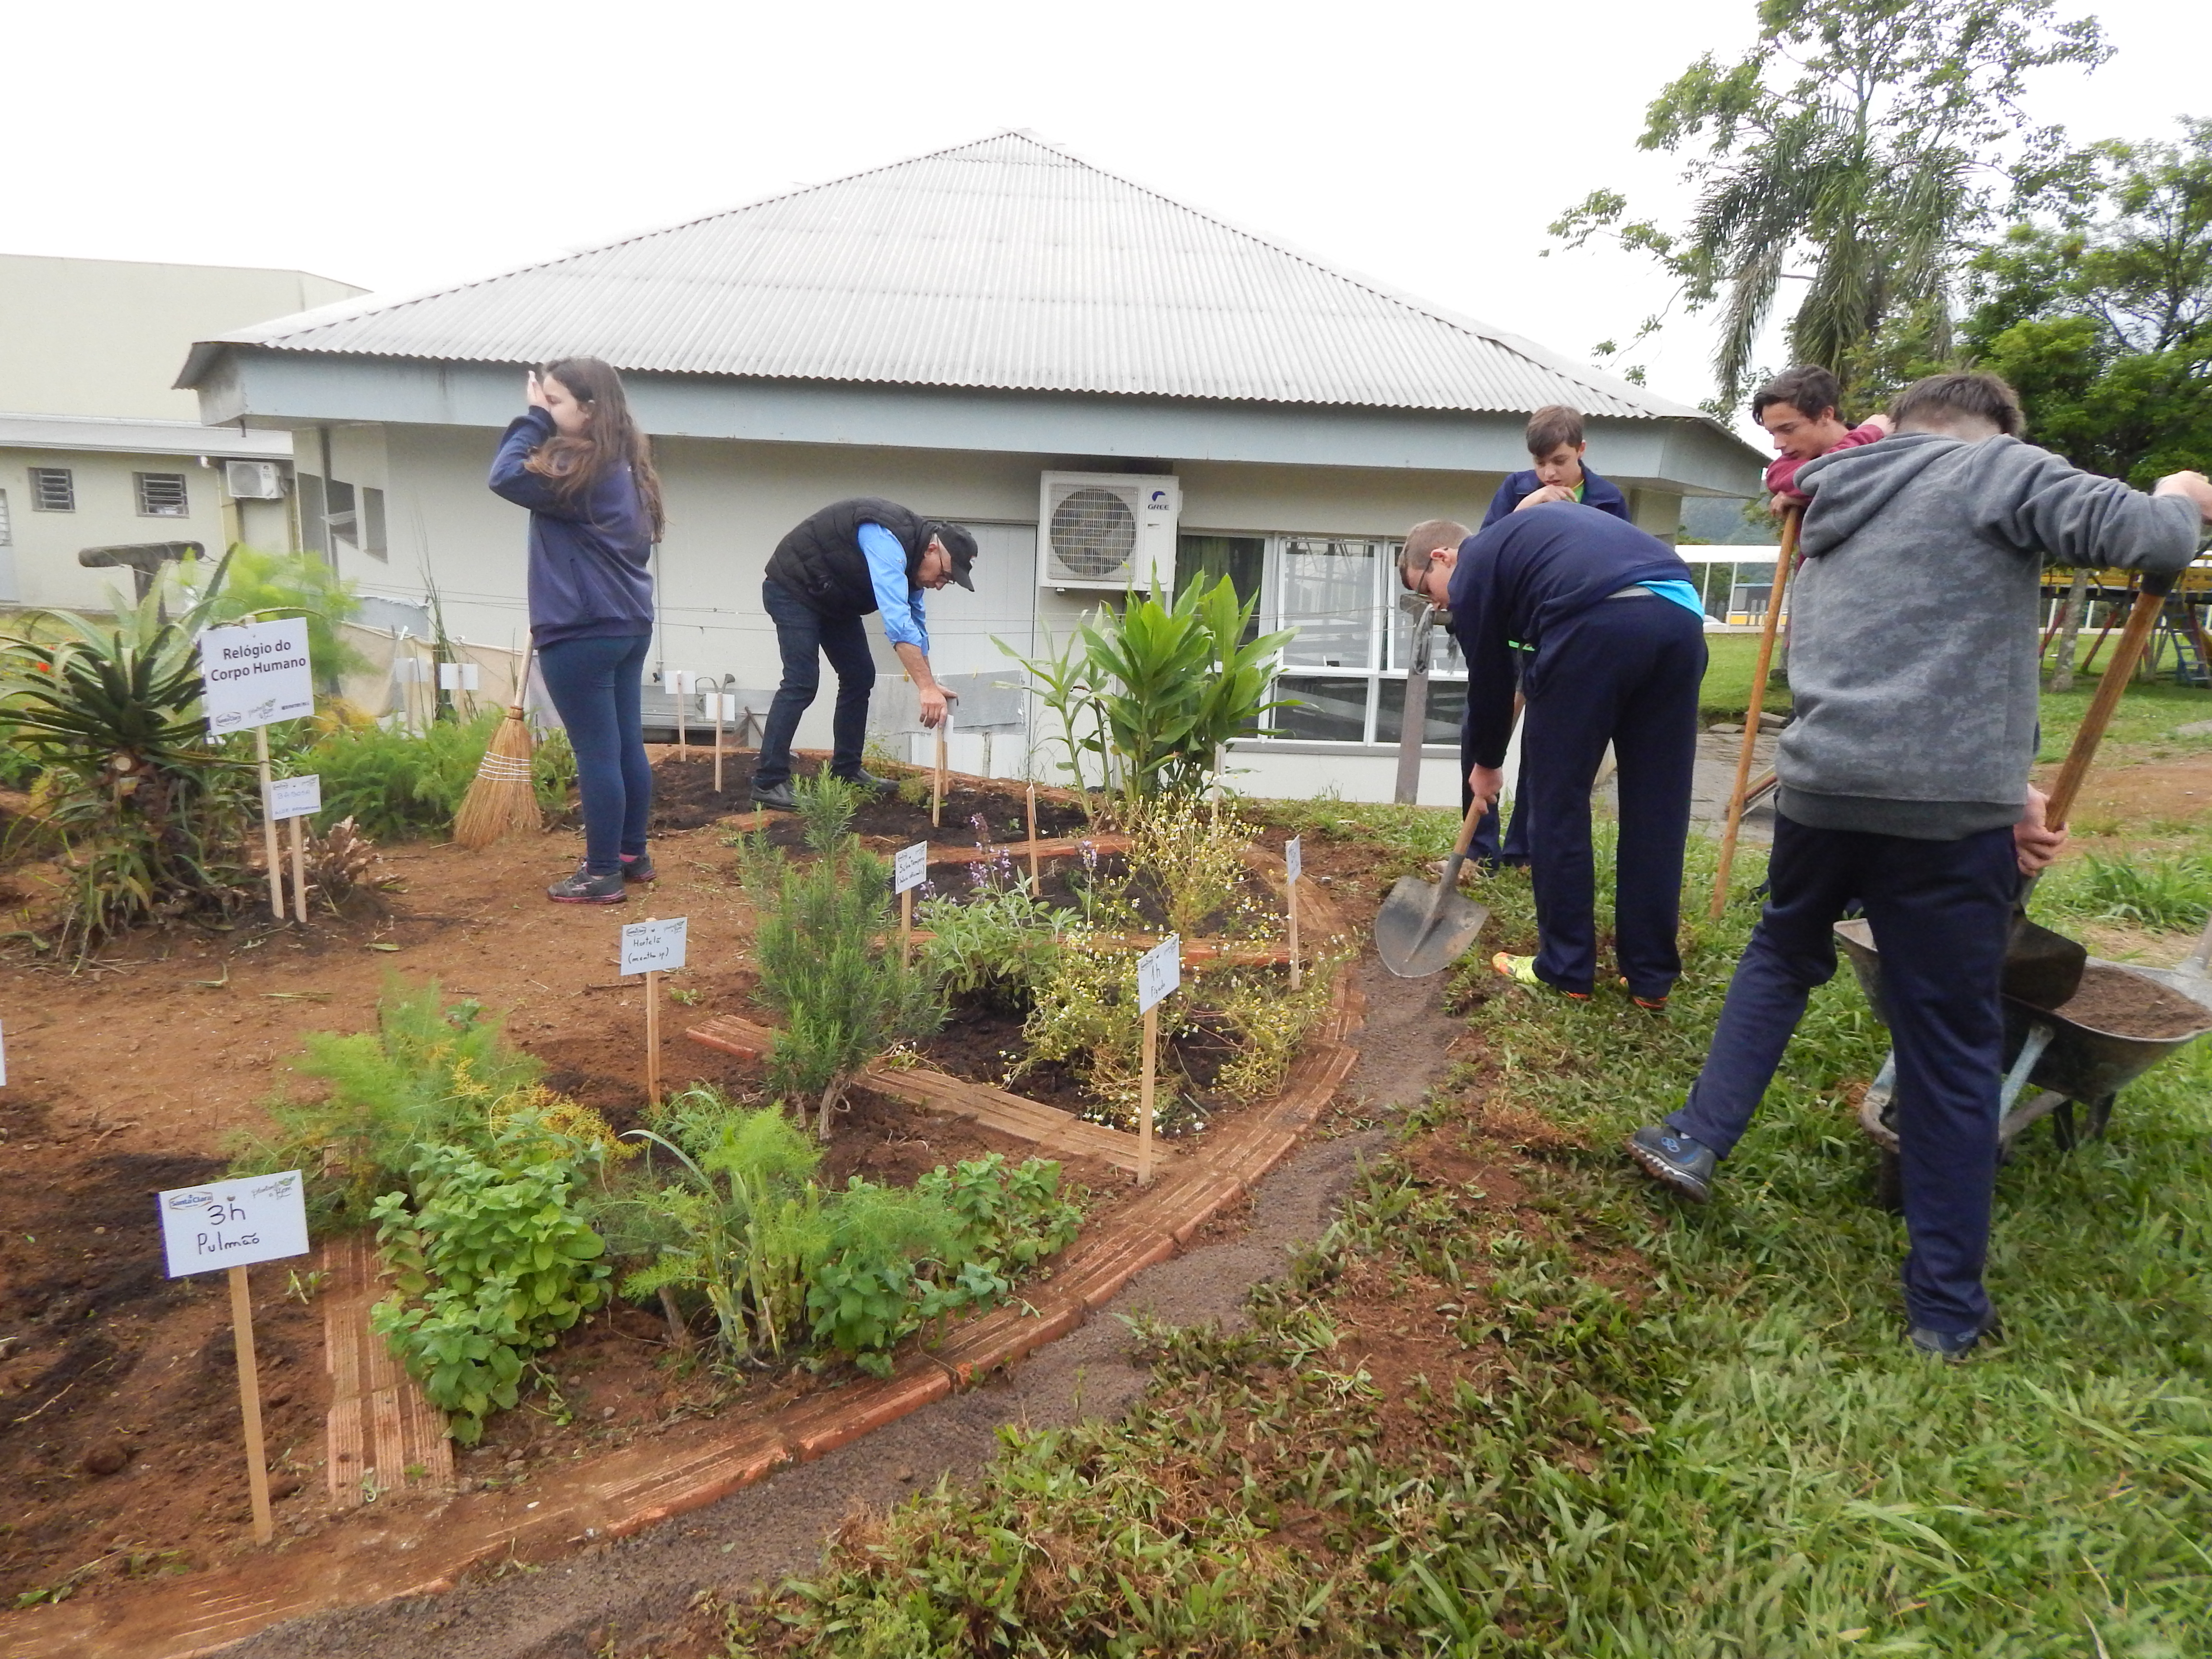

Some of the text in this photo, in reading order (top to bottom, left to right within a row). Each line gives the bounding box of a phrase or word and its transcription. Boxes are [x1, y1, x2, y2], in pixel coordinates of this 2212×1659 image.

[223, 639, 291, 660] Relógio do
[211, 658, 306, 681] Corpo Humano
[633, 936, 661, 947] Hortelã
[207, 1202, 246, 1226] 3h
[197, 1231, 260, 1255] Pulmão
